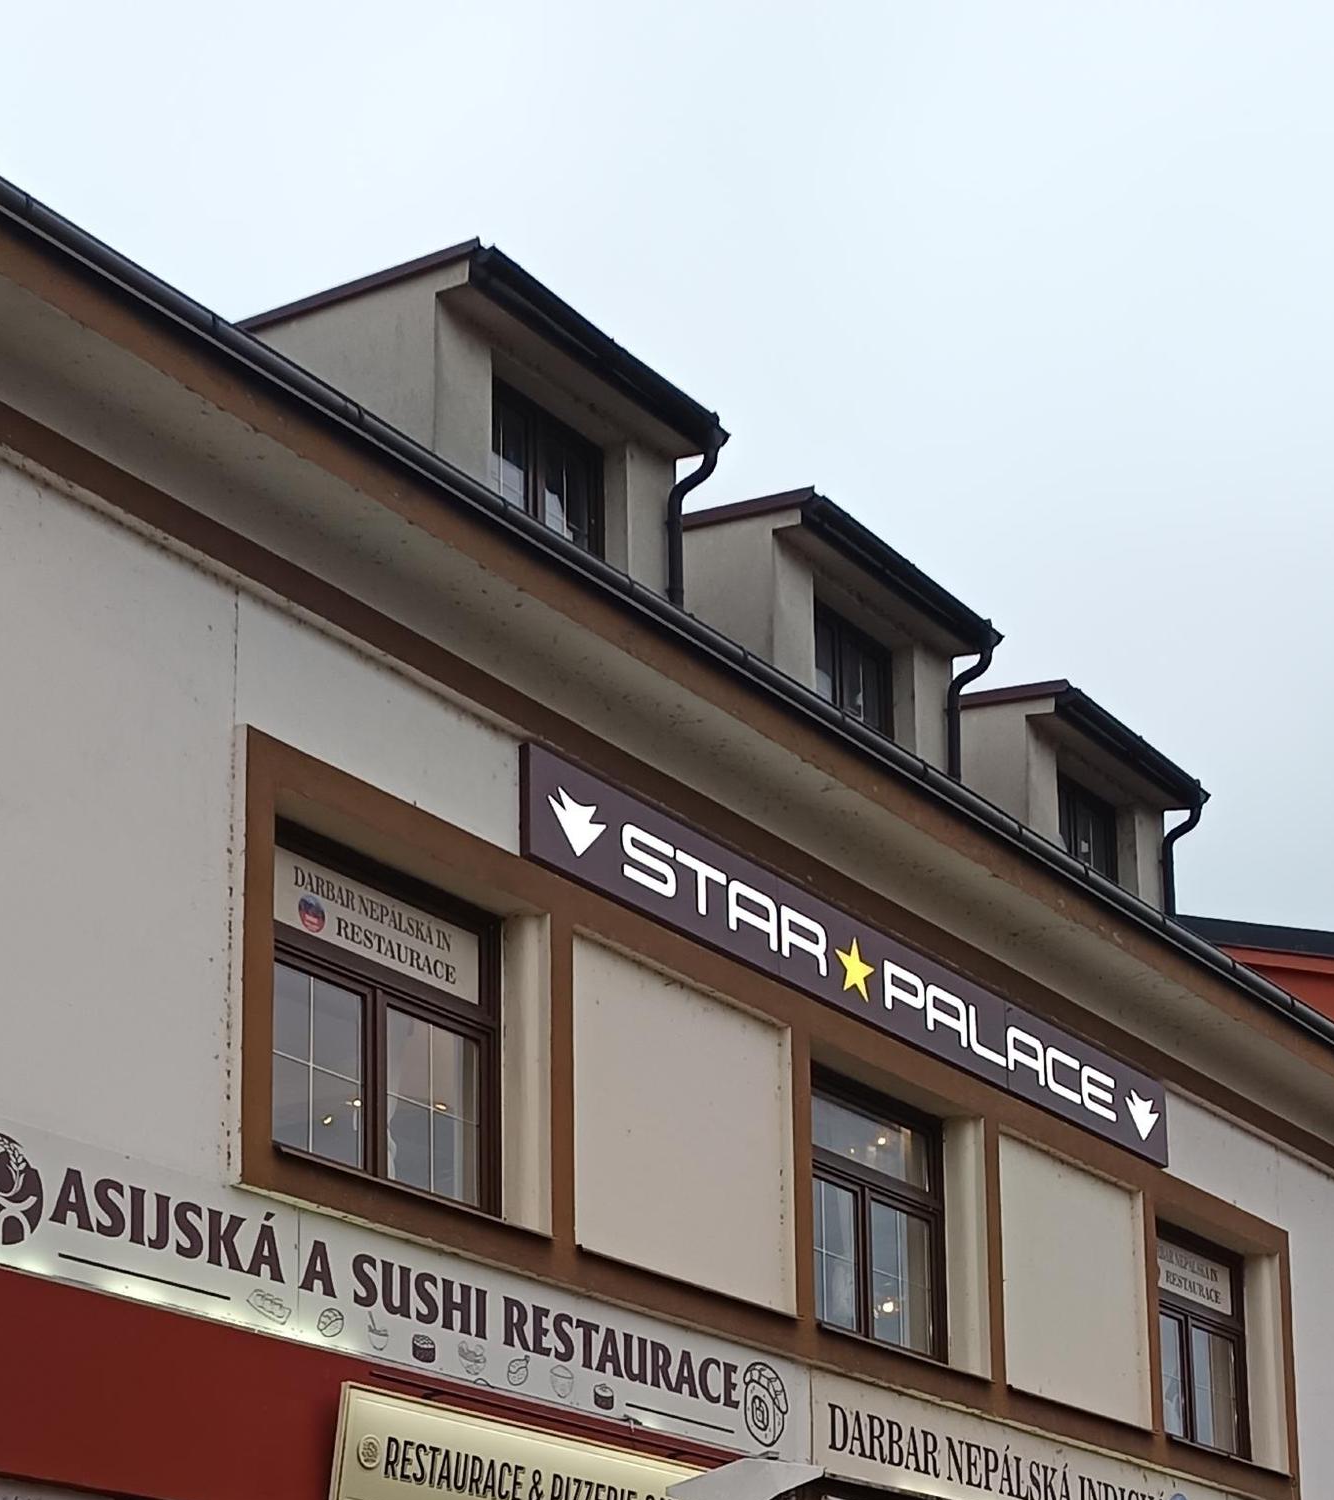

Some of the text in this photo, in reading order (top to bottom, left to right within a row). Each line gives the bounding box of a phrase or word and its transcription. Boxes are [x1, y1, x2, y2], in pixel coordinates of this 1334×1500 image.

[293, 865, 453, 953] DARBAR NEPÁLSKÁ IN
[335, 917, 457, 985] RESTAURACE
[620, 822, 1118, 1122] STAR PALACE
[49, 1167, 741, 1411] ASIJSKÁ A SUSHI RESTAURACE
[1165, 1270, 1221, 1305] RESTAURACE
[827, 1402, 940, 1479] DARBAR
